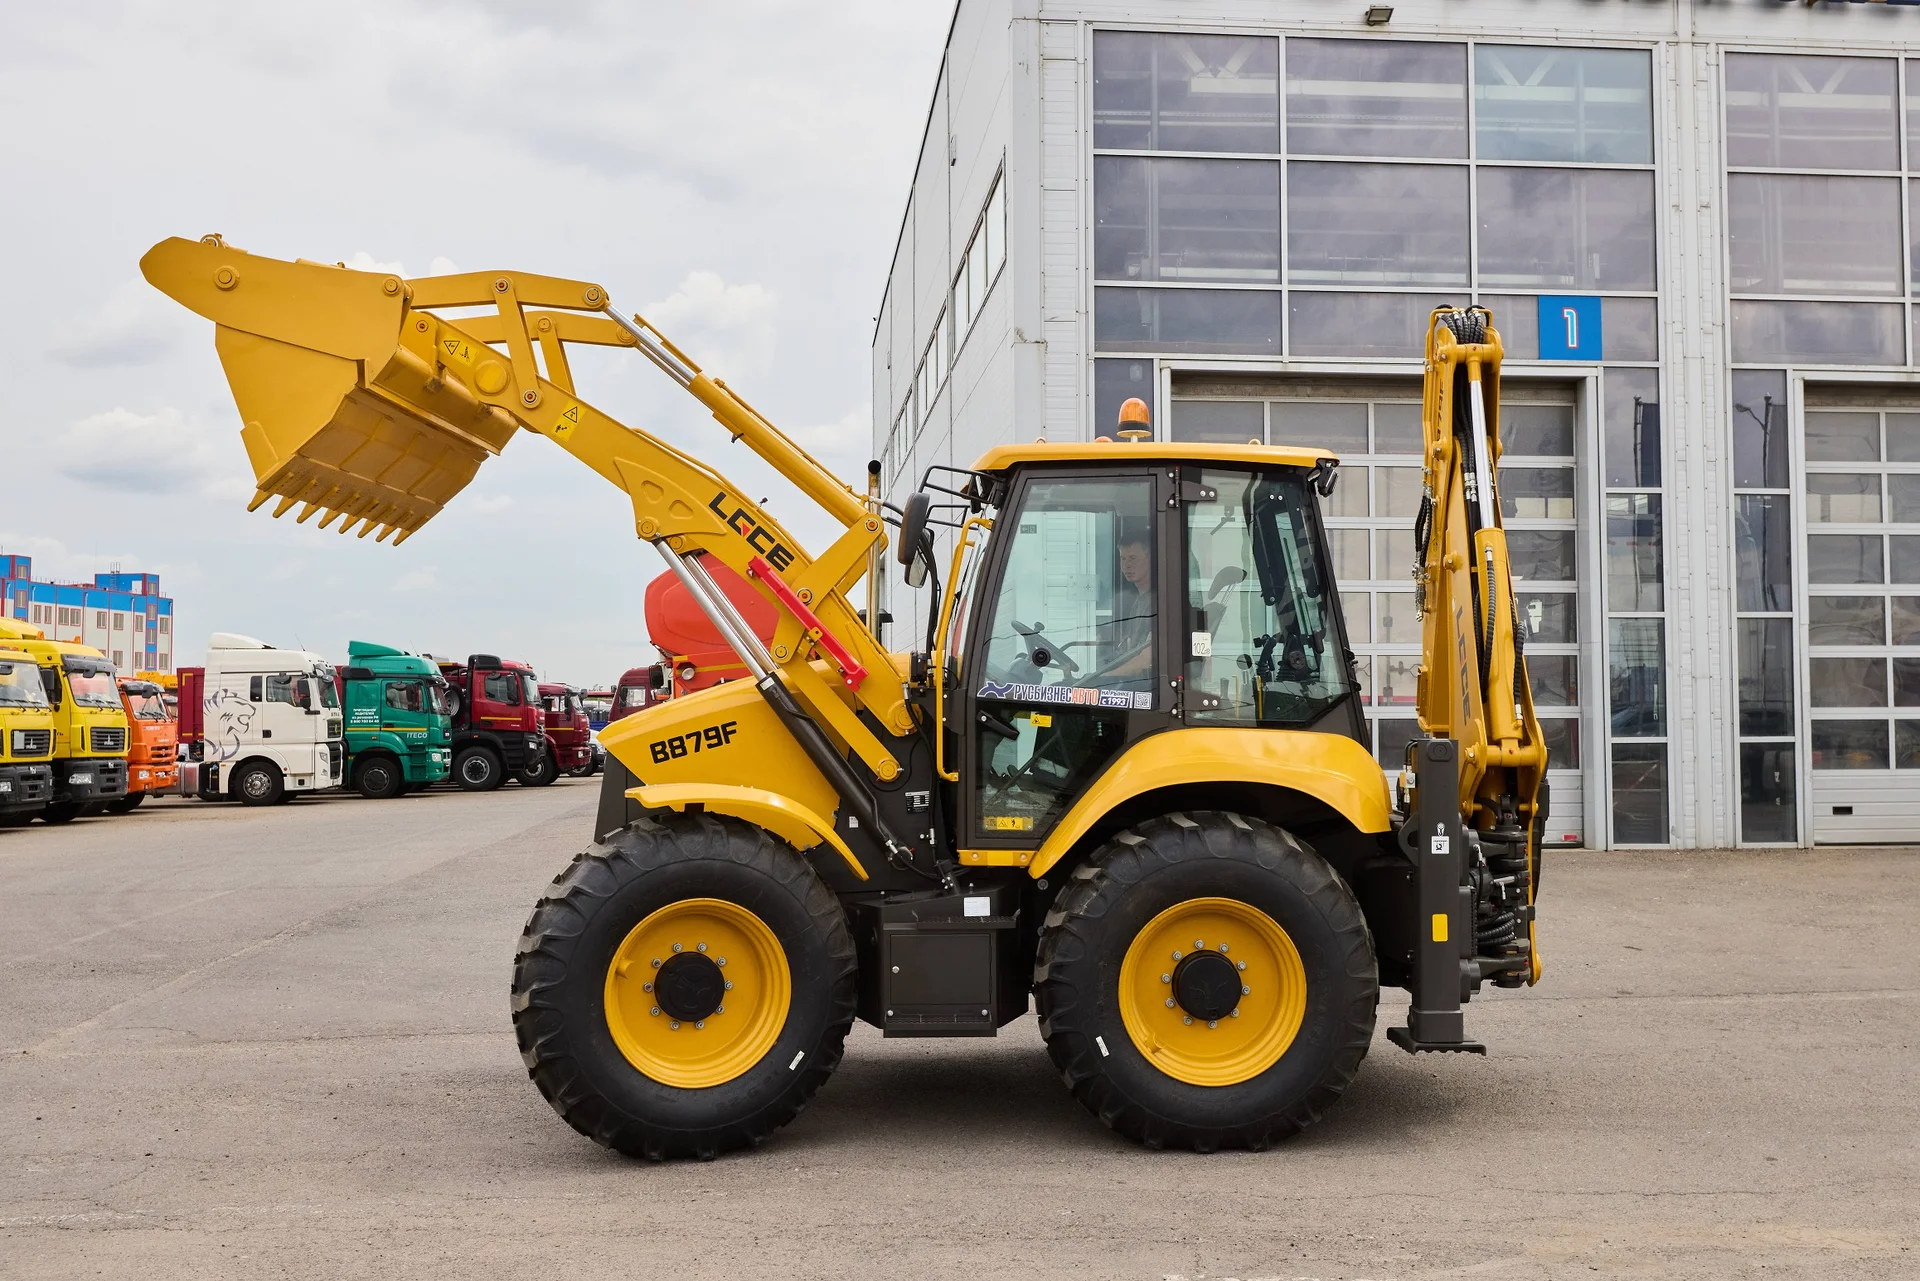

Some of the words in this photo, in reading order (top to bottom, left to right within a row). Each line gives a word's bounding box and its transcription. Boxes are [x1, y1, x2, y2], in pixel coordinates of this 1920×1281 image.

[1562, 307, 1578, 348] 1
[708, 491, 795, 573] LGCE
[1456, 605, 1471, 727] LGCE
[1014, 684, 1099, 706] РУСБИЗНЕСАВТО
[1107, 698, 1126, 706] 1993
[649, 720, 738, 764] B879F
